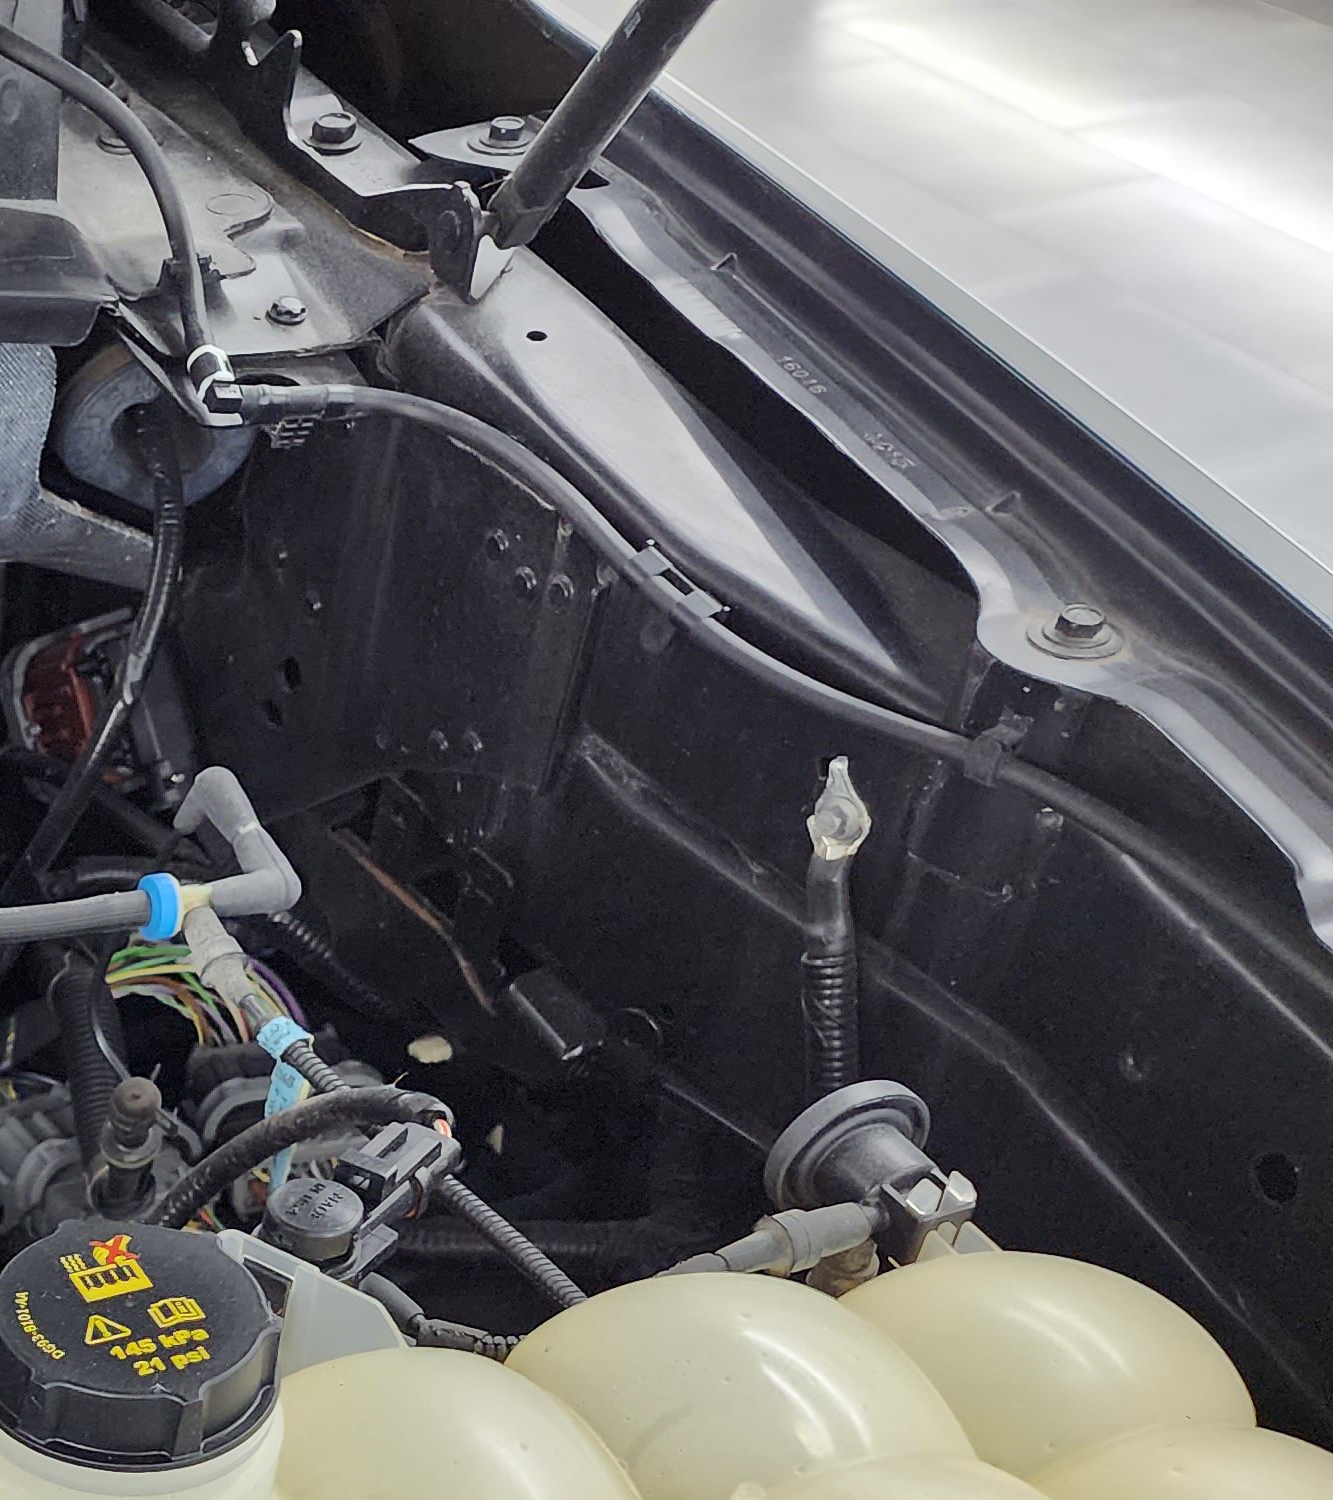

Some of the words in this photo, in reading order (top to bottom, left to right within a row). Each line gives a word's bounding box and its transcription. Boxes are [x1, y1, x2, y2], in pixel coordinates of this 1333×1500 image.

[109, 1337, 158, 1361] 145
[159, 1328, 211, 1350] kPa
[132, 1357, 167, 1378] 21
[169, 1346, 212, 1371] psi
